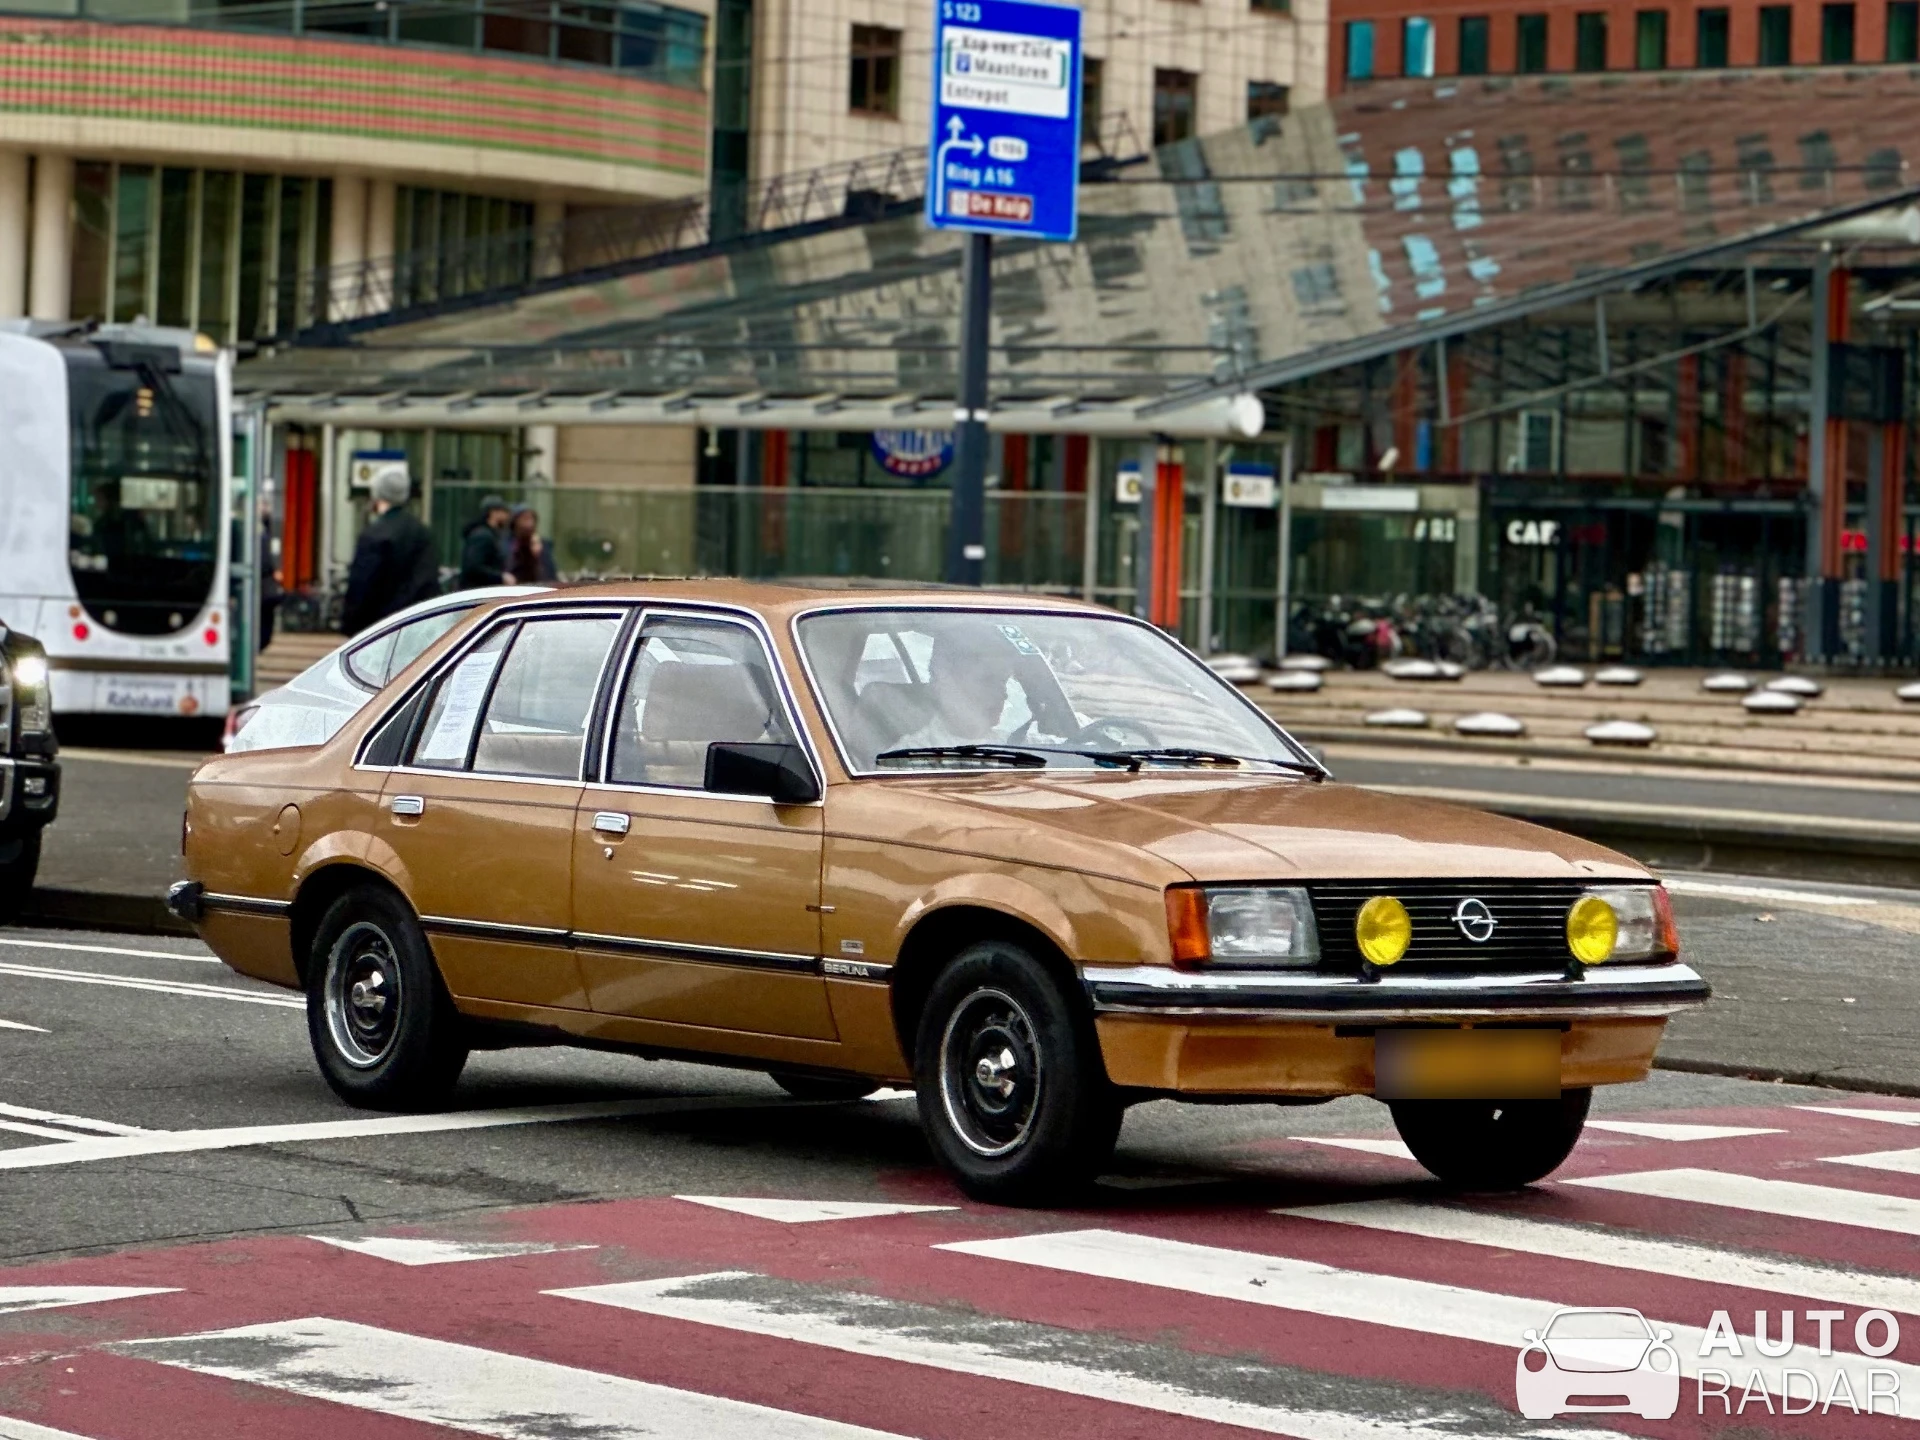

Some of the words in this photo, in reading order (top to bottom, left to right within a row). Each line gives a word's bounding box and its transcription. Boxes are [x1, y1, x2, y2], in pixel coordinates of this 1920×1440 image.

[943, 0, 953, 19] S
[956, 3, 981, 22] 123
[974, 58, 1049, 80] Maastoren
[946, 82, 1008, 104] Entrepot
[947, 163, 980, 187] Ring
[971, 193, 991, 213] De
[995, 196, 1030, 219] Kuip
[824, 962, 869, 977] BERLINA
